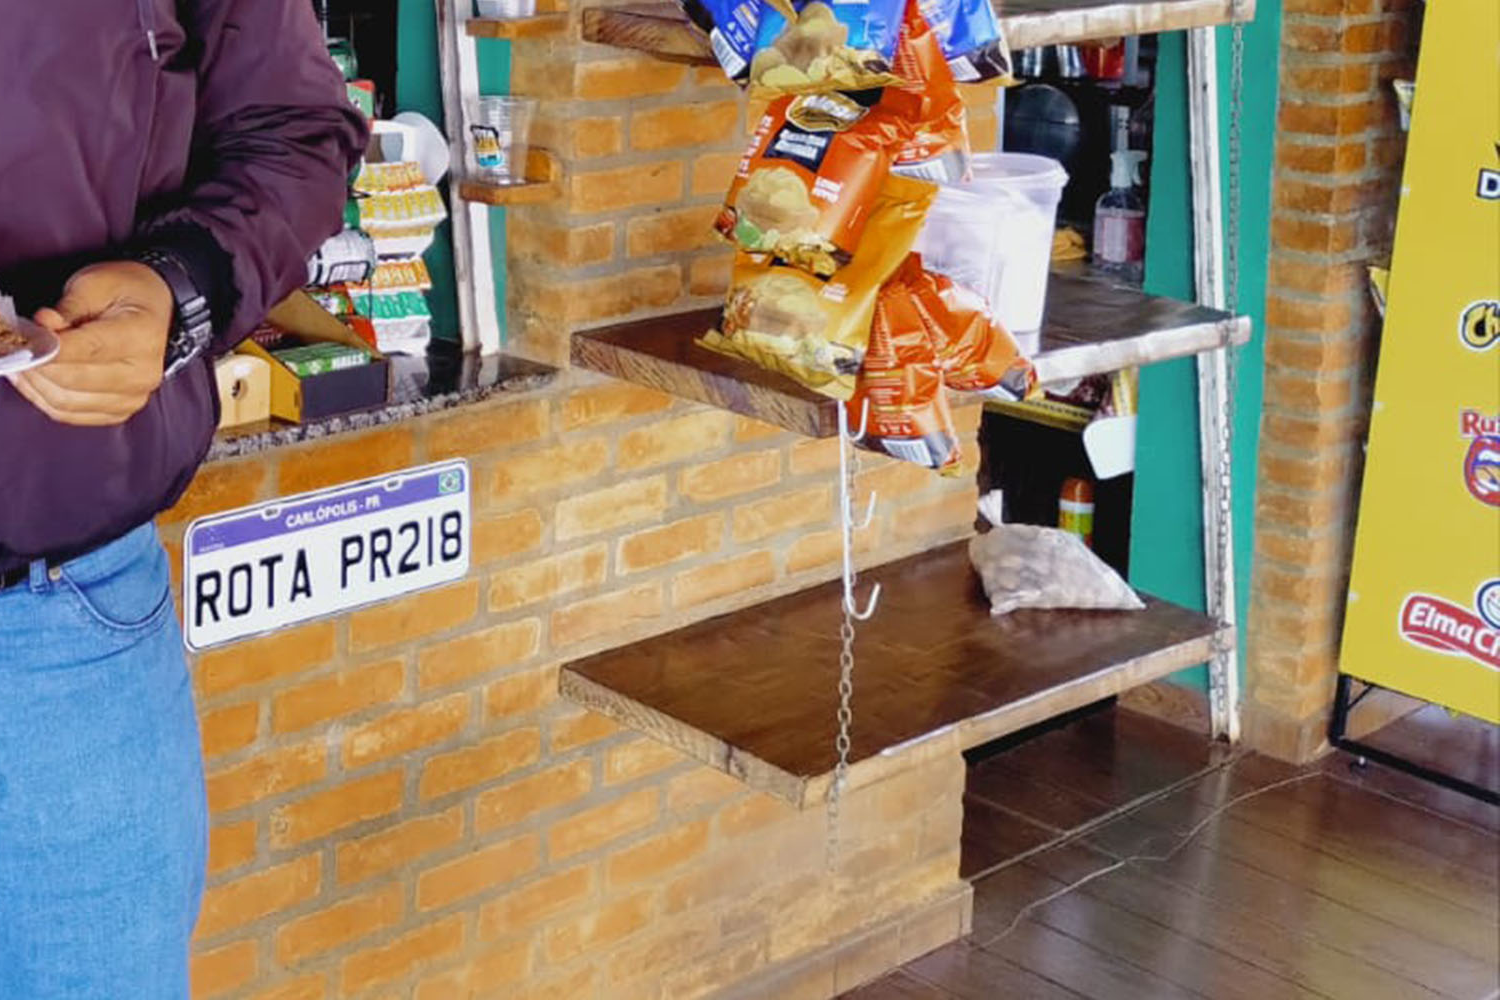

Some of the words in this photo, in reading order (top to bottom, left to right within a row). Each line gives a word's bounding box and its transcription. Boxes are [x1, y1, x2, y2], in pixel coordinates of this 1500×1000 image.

[285, 501, 358, 528] CARLÓPOLIS
[365, 495, 381, 509] PR
[195, 549, 312, 627] ROTA
[340, 510, 462, 590] PR218
[1409, 602, 1474, 643] Elma
